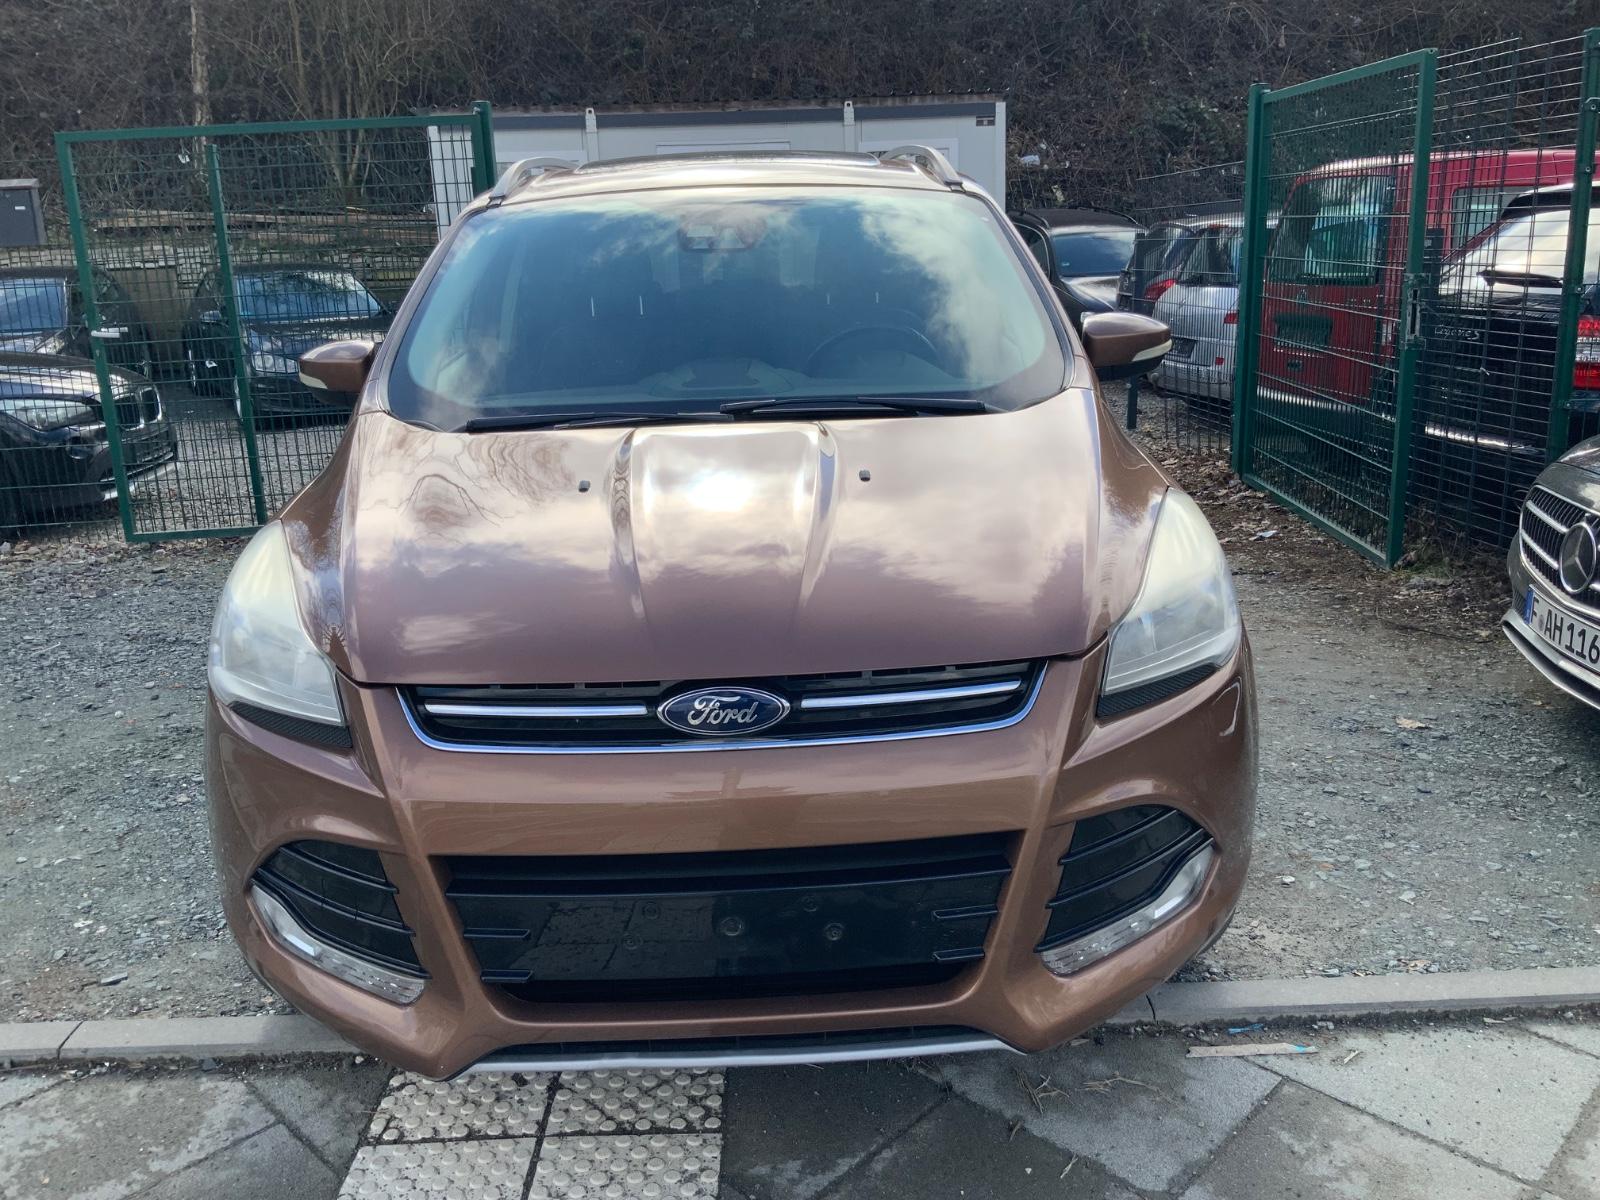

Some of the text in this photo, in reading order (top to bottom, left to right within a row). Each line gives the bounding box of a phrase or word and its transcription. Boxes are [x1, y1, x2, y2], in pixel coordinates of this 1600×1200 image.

[1531, 596, 1600, 664] F AH 116
[687, 695, 757, 725] Ford
